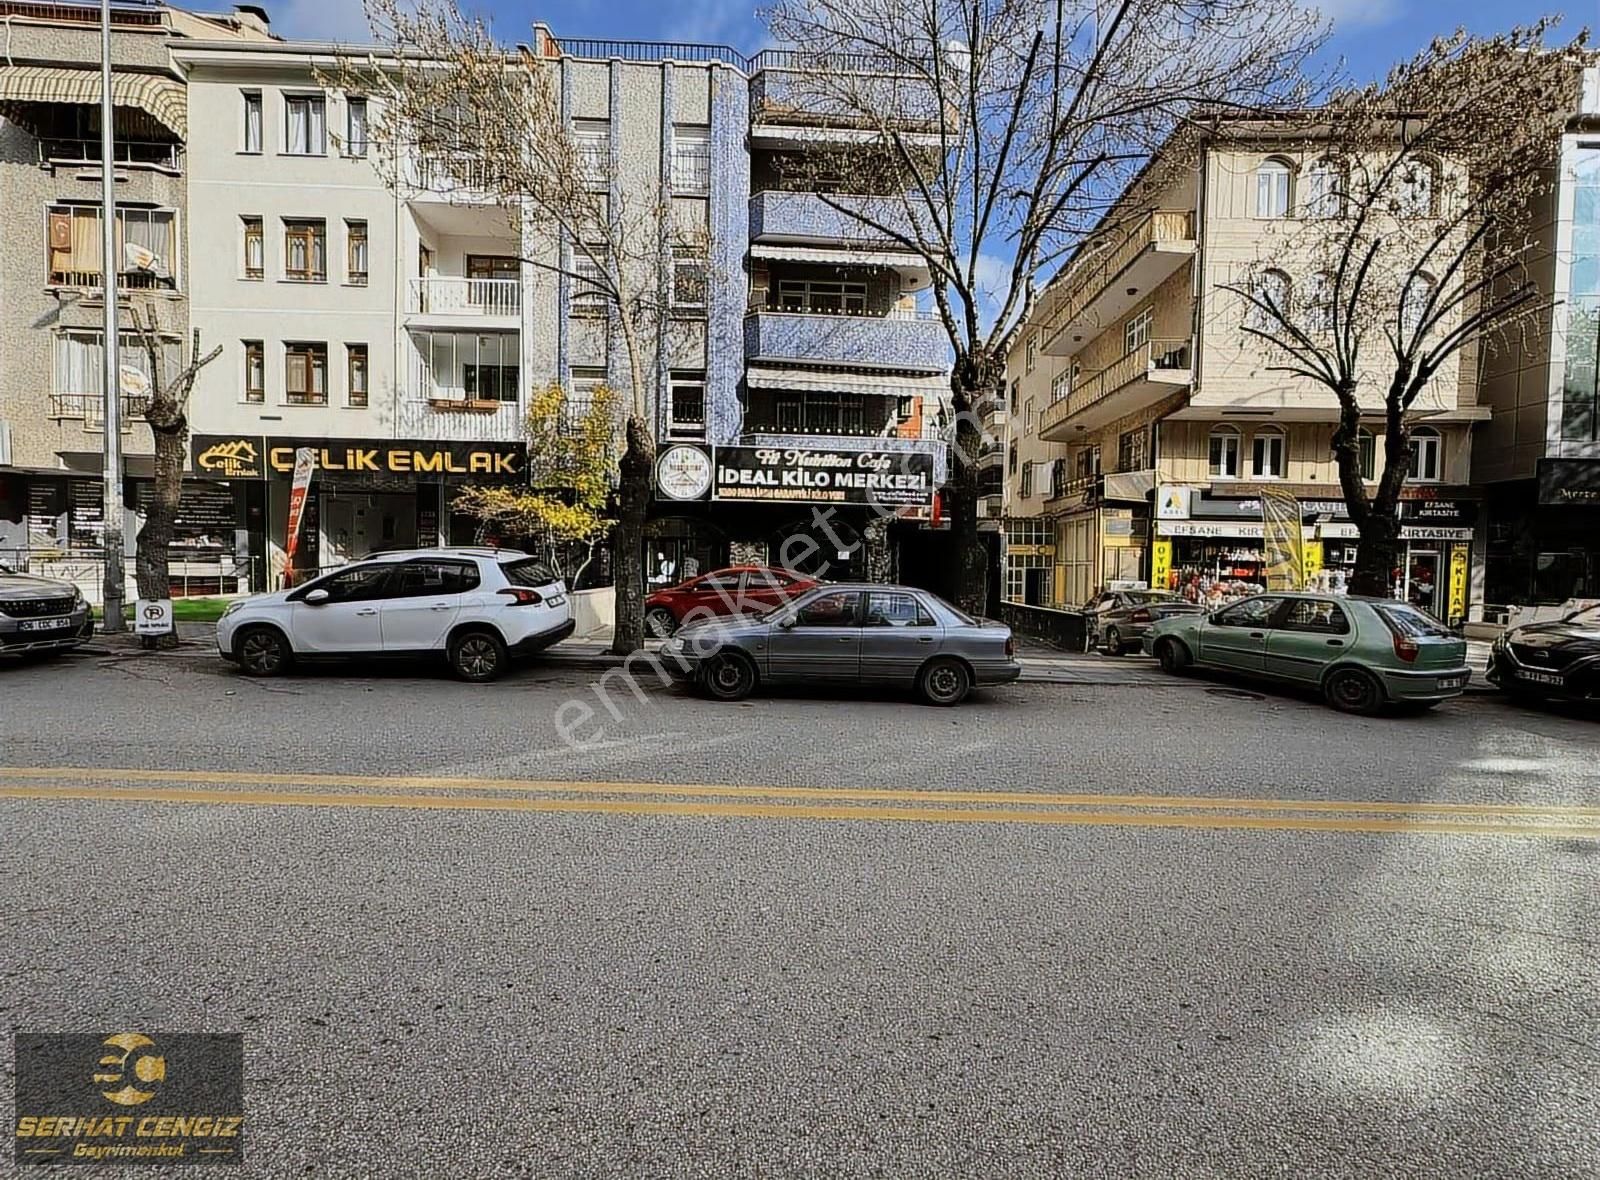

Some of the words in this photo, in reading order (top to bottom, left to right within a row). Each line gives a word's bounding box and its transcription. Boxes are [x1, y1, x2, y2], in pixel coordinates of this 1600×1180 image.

[388, 450, 517, 473] EMLAK
[784, 449, 852, 467] Nutrition
[857, 452, 891, 471] Cafe
[718, 464, 779, 485] İDEAL
[782, 467, 831, 487] KİLO
[834, 471, 926, 490] MERKEZİ
[1424, 501, 1456, 509] EFSANE
[1174, 525, 1222, 535] EFSANE
